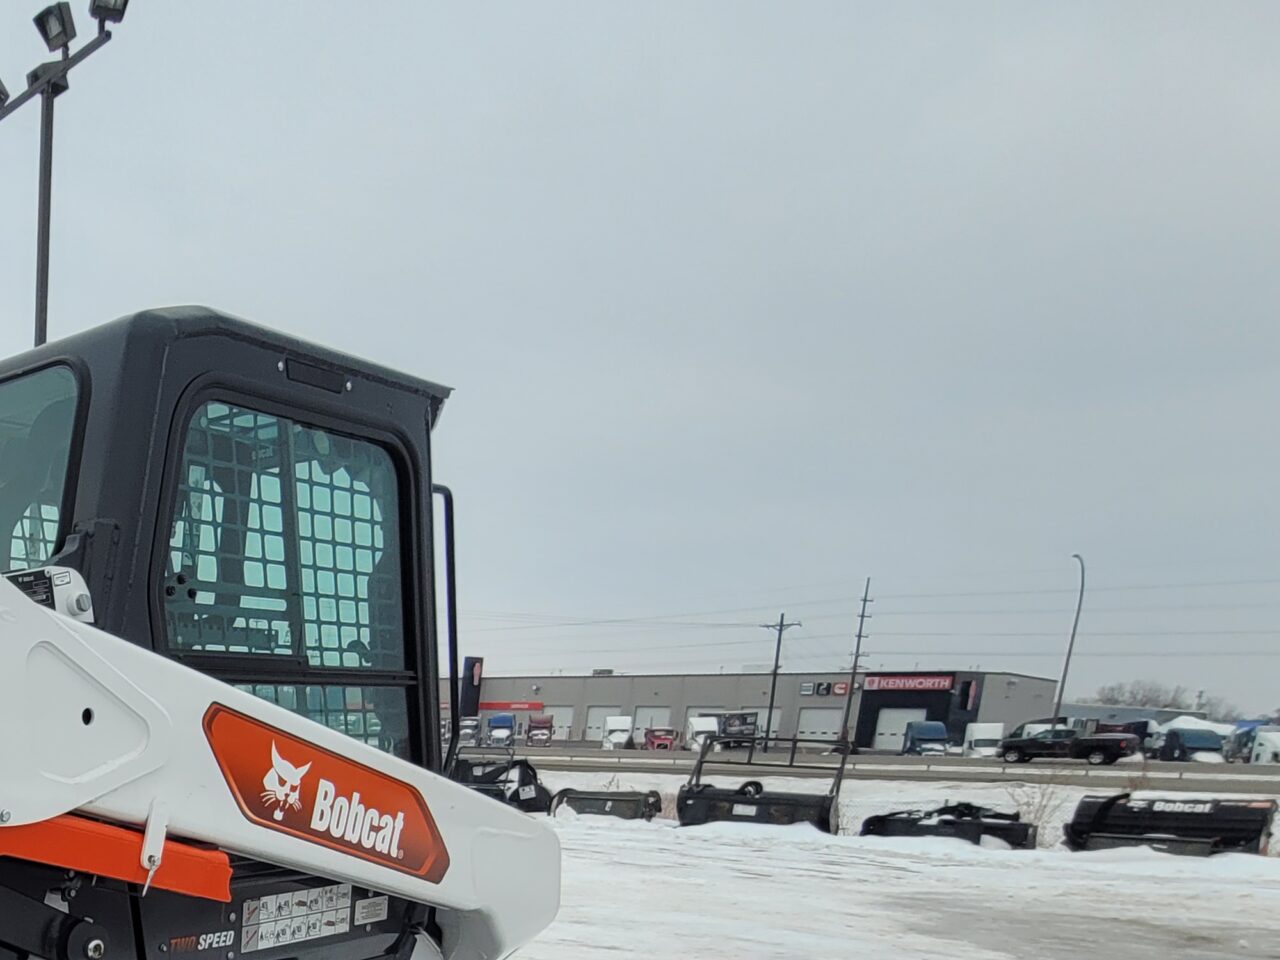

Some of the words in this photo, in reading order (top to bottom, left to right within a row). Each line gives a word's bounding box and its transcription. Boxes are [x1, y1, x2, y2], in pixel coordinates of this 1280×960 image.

[878, 679, 951, 690] KENWORTH
[1152, 801, 1214, 813] Bobcat
[310, 778, 405, 860] Bobcat
[170, 935, 197, 952] TWO
[197, 930, 235, 951] SPEED
